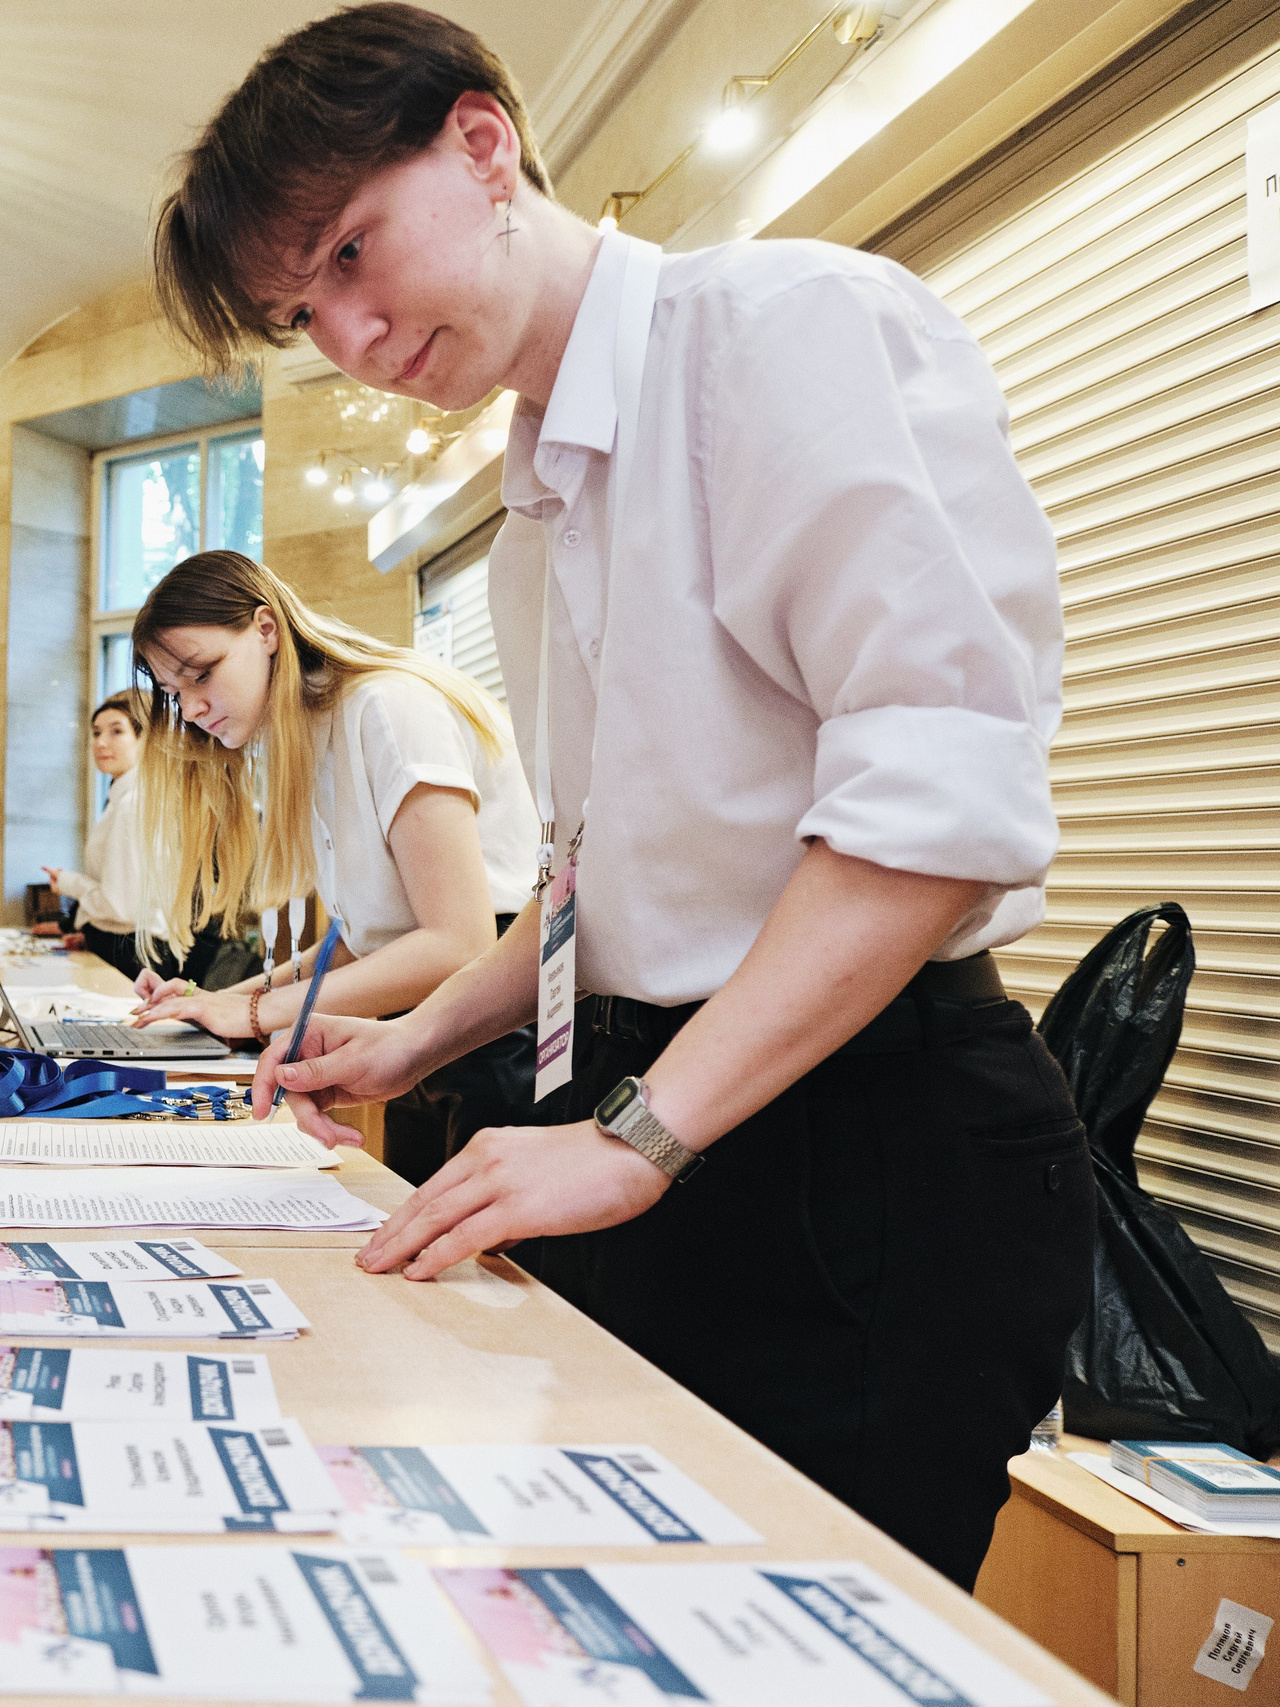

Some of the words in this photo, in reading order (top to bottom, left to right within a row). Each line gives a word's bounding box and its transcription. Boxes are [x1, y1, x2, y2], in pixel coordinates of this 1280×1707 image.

[538, 1030, 570, 1065] ОРГАНИЗАТОР
[90, 1252, 113, 1270] Филиппов
[105, 1252, 129, 1270] Александр
[122, 1250, 148, 1270] Евгеньевич
[151, 1247, 200, 1274] ДОКЛАДЧИК
[222, 1290, 263, 1326] ДОКЛАДЧИК
[199, 1365, 228, 1416] ДОКЛАДЧИК
[224, 1437, 279, 1507] ДОКЛАДЧИК
[587, 1462, 687, 1536] ДОКЛАДЧИК
[316, 1568, 403, 1675] ДОКЛАДЧИК
[1208, 1623, 1232, 1660] Поляков
[1222, 1632, 1243, 1662] Сергей
[1231, 1628, 1257, 1674] Сергеевич
